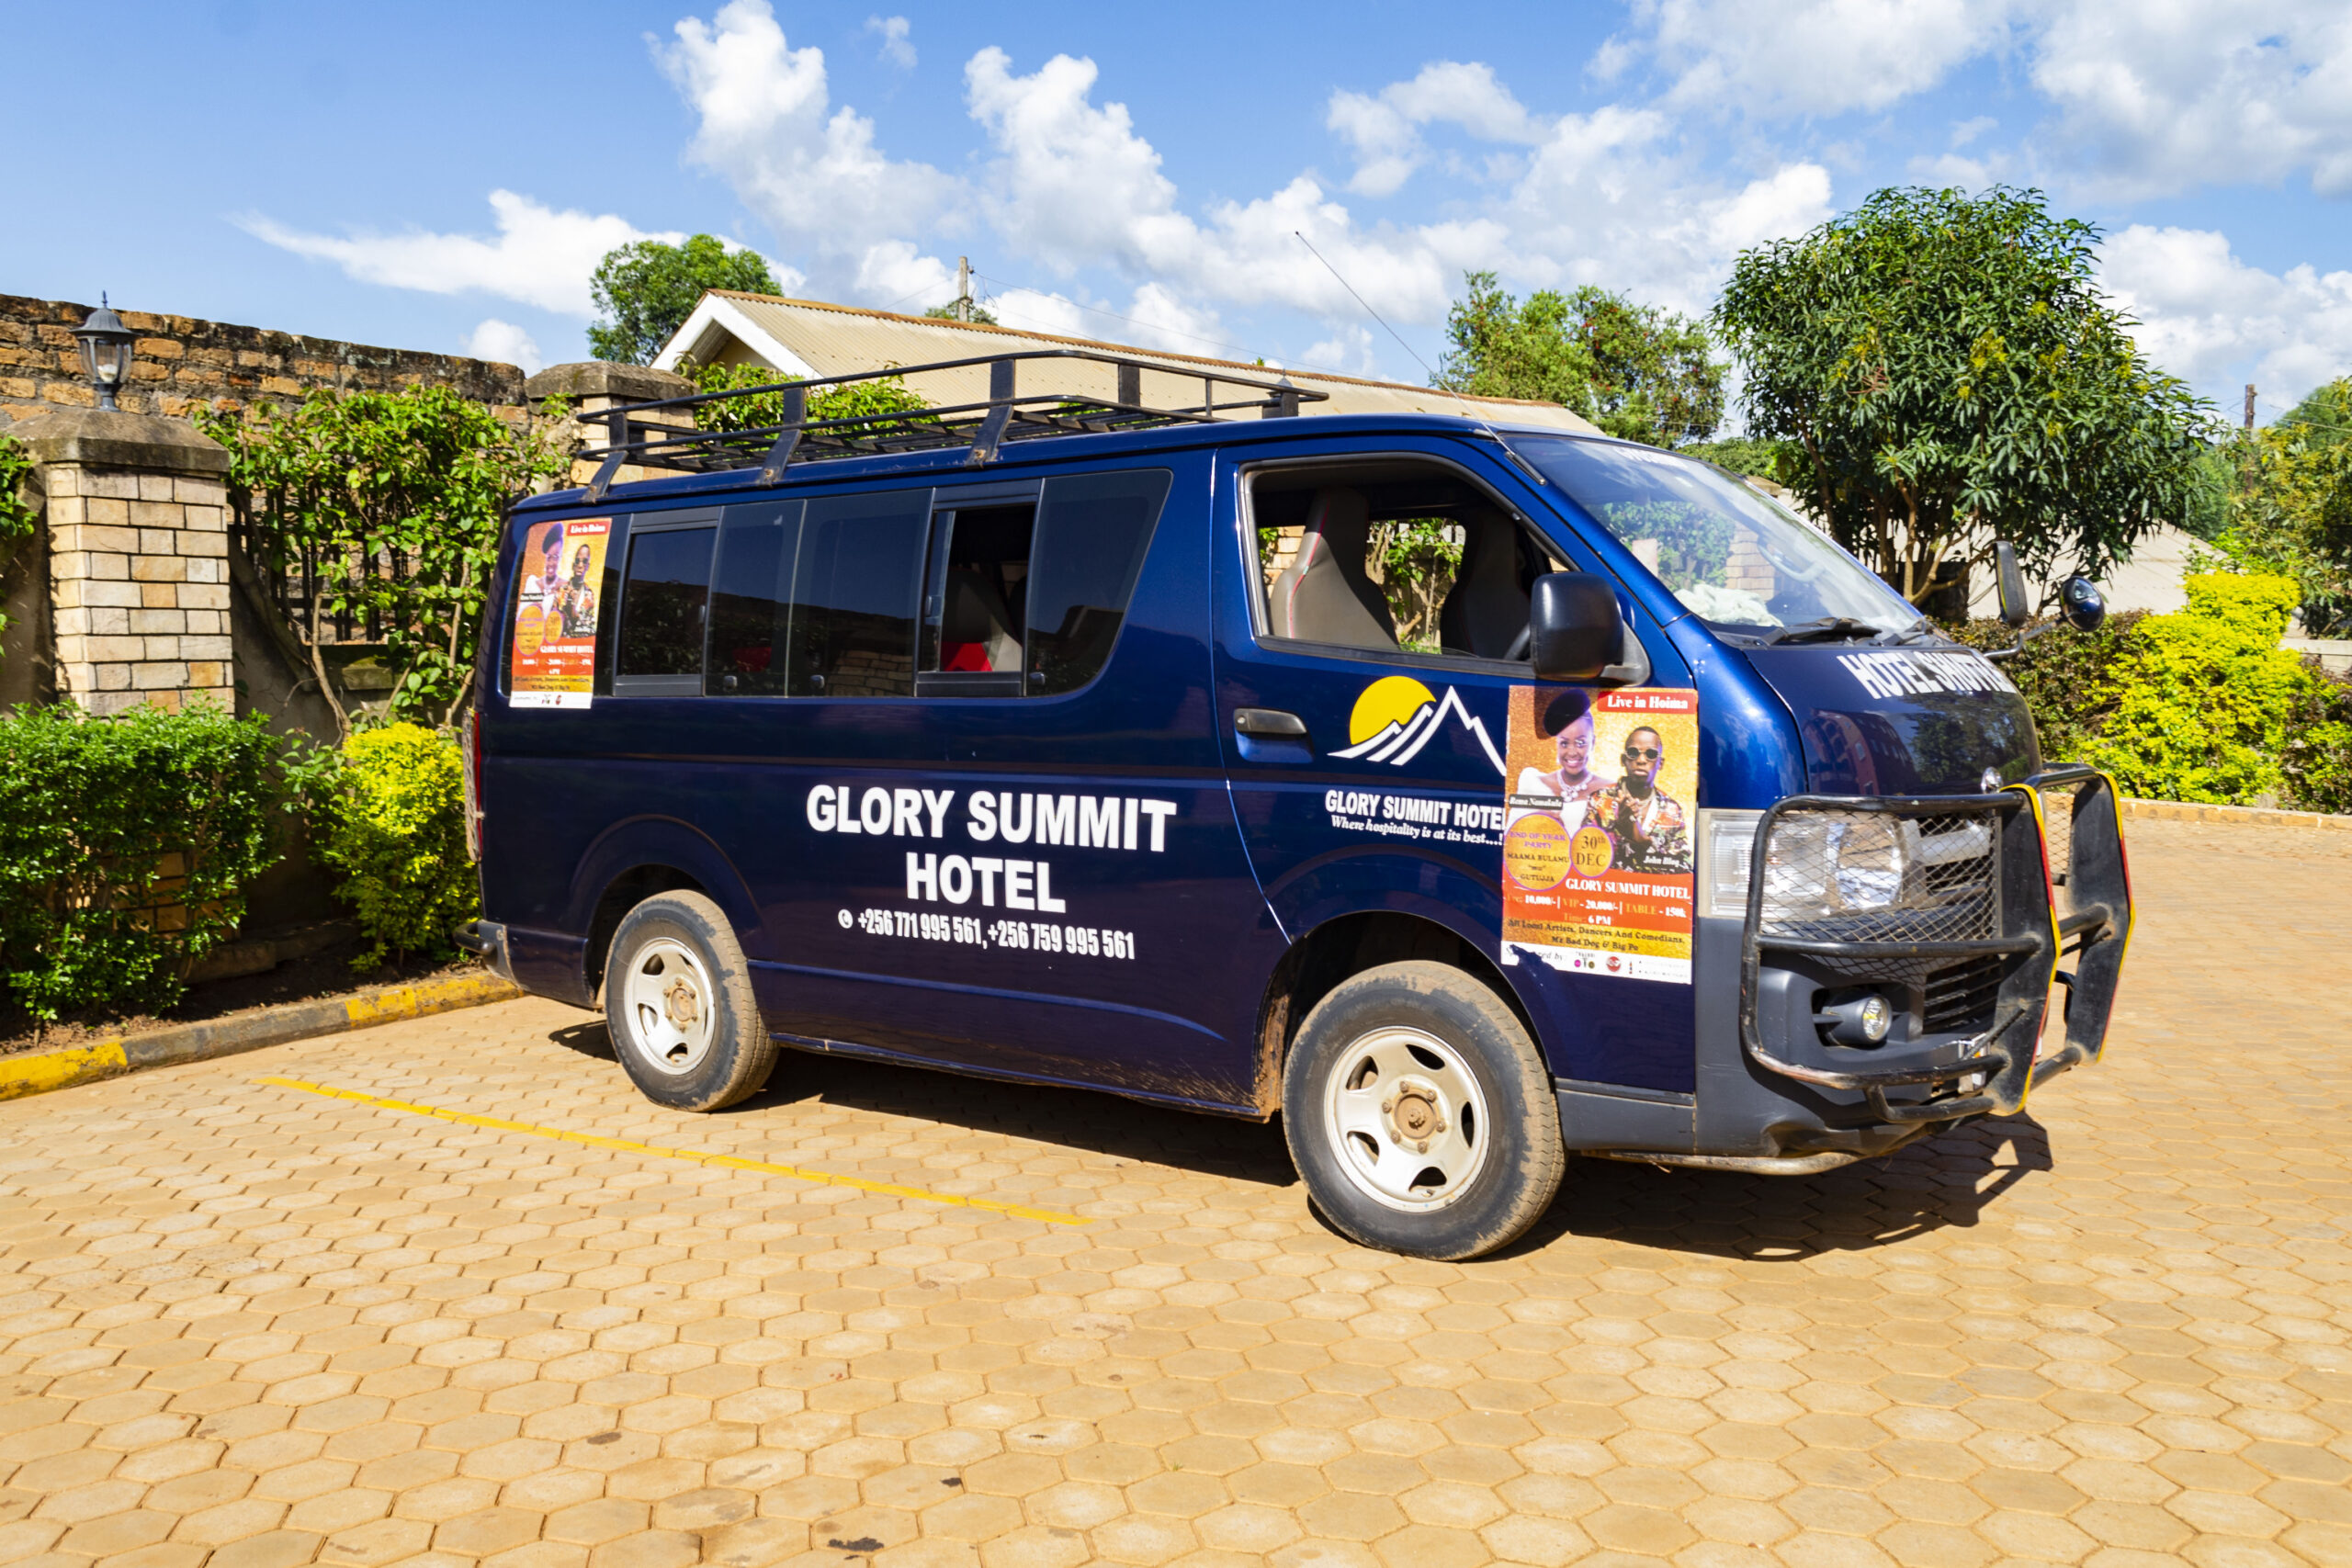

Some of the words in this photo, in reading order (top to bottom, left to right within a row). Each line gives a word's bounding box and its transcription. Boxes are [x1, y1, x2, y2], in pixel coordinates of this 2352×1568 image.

[1837, 652, 1944, 699] HOTEL
[1607, 695, 1633, 707] Live
[1634, 695, 1646, 708] in
[1649, 696, 1689, 709] Hoima
[1325, 789, 1381, 817] GLORY
[1382, 795, 1452, 825] SUMMIT
[807, 784, 956, 838] GLORY
[967, 790, 1177, 852] SUMMIT
[1330, 815, 1365, 829] Where
[1365, 818, 1420, 840] hospitality
[1421, 826, 1431, 838] is
[1433, 829, 1445, 840] at
[1446, 829, 1461, 841] its
[1524, 840, 1551, 849] PARTY
[1581, 835, 1606, 850] 30th
[1577, 852, 1606, 867] DEC
[906, 852, 1066, 913] HOTEL
[1565, 878, 1602, 892] GLORY
[1604, 881, 1651, 896] SUMMIT
[1651, 885, 1691, 899] HOTEL
[1563, 897, 1579, 908] VIP
[1625, 903, 1657, 915] TABLE
[1588, 915, 1594, 924] 6
[1595, 915, 1611, 926] PM
[858, 908, 893, 936] +256
[894, 911, 919, 938] 771
[920, 913, 951, 942] 995
[953, 916, 988, 950] 561,
[988, 919, 1029, 949] +256
[1031, 922, 1062, 953] 759
[1065, 926, 1099, 956] 995
[1102, 929, 1135, 960] 561
[1578, 926, 1612, 936] Dancers
[1615, 930, 1633, 938] And
[1583, 939, 1600, 949] Dog
[1612, 942, 1625, 951] Big
